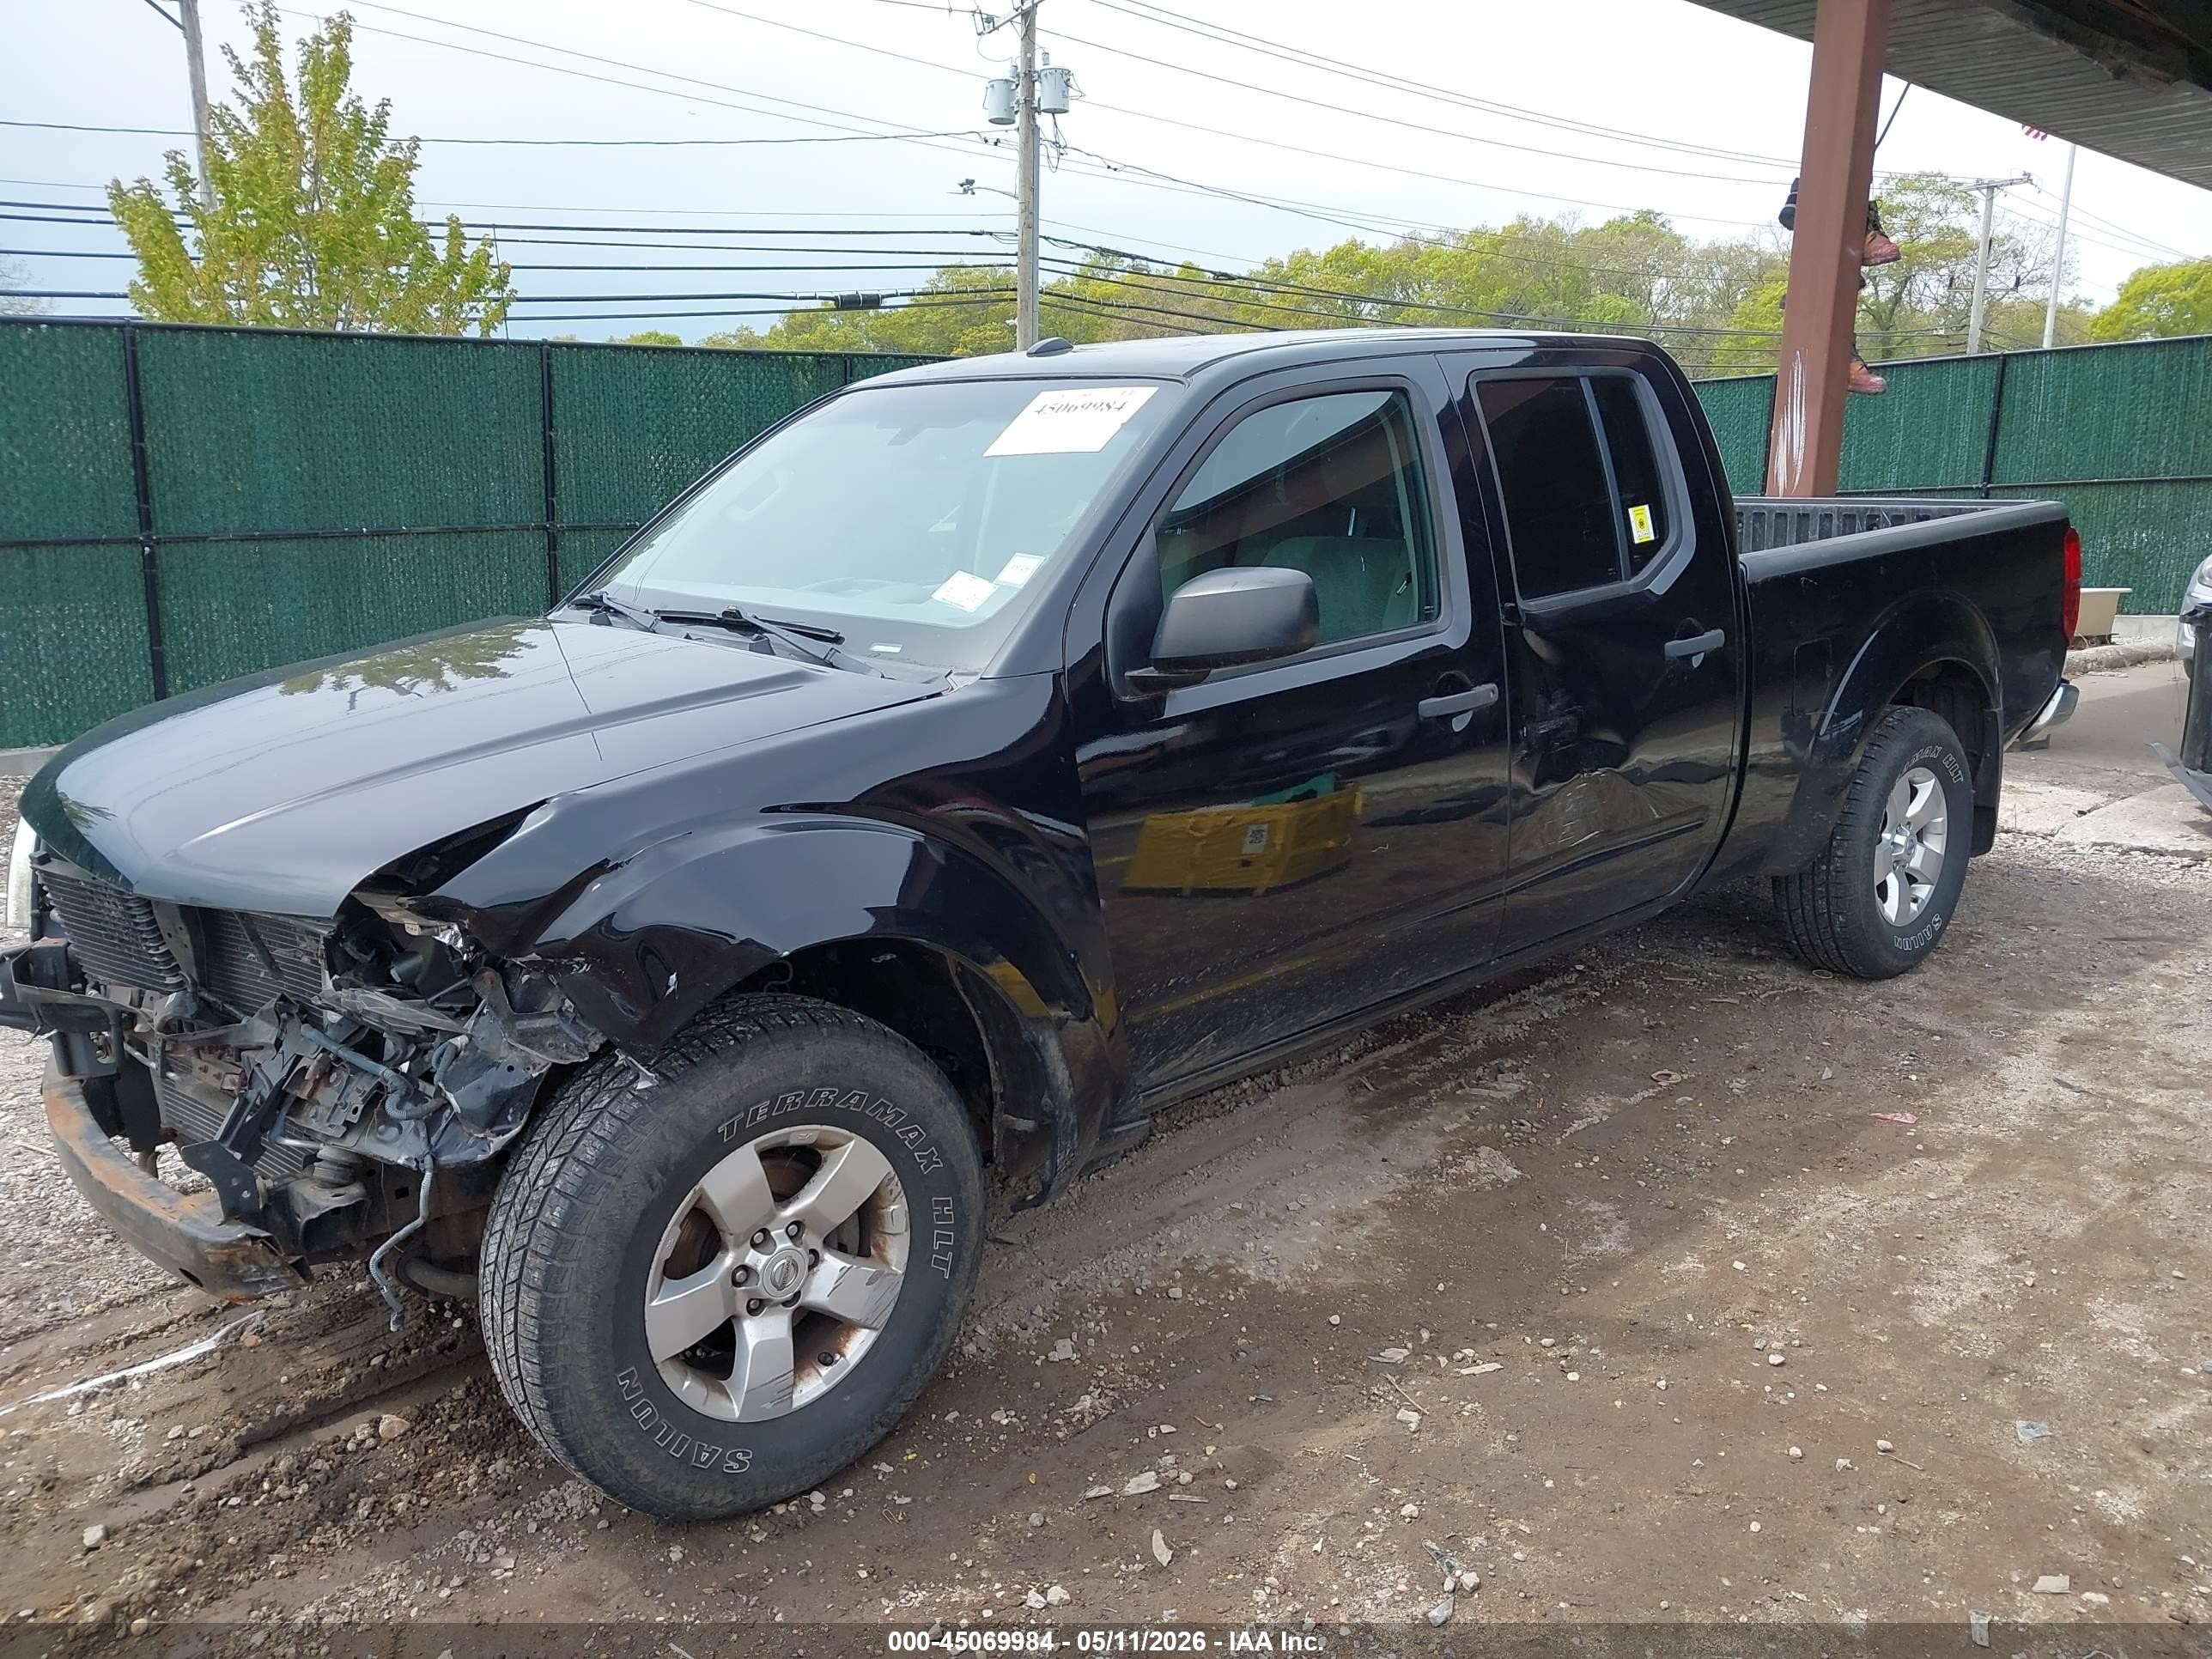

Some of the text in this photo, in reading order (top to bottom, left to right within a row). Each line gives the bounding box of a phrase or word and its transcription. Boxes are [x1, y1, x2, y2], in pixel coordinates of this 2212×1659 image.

[1896, 746, 1964, 783] AMAX HLT
[1893, 913, 1942, 951] SAILUN
[718, 1088, 955, 1279] TERRAMAX HLT
[617, 1366, 753, 1474] SAILUN
